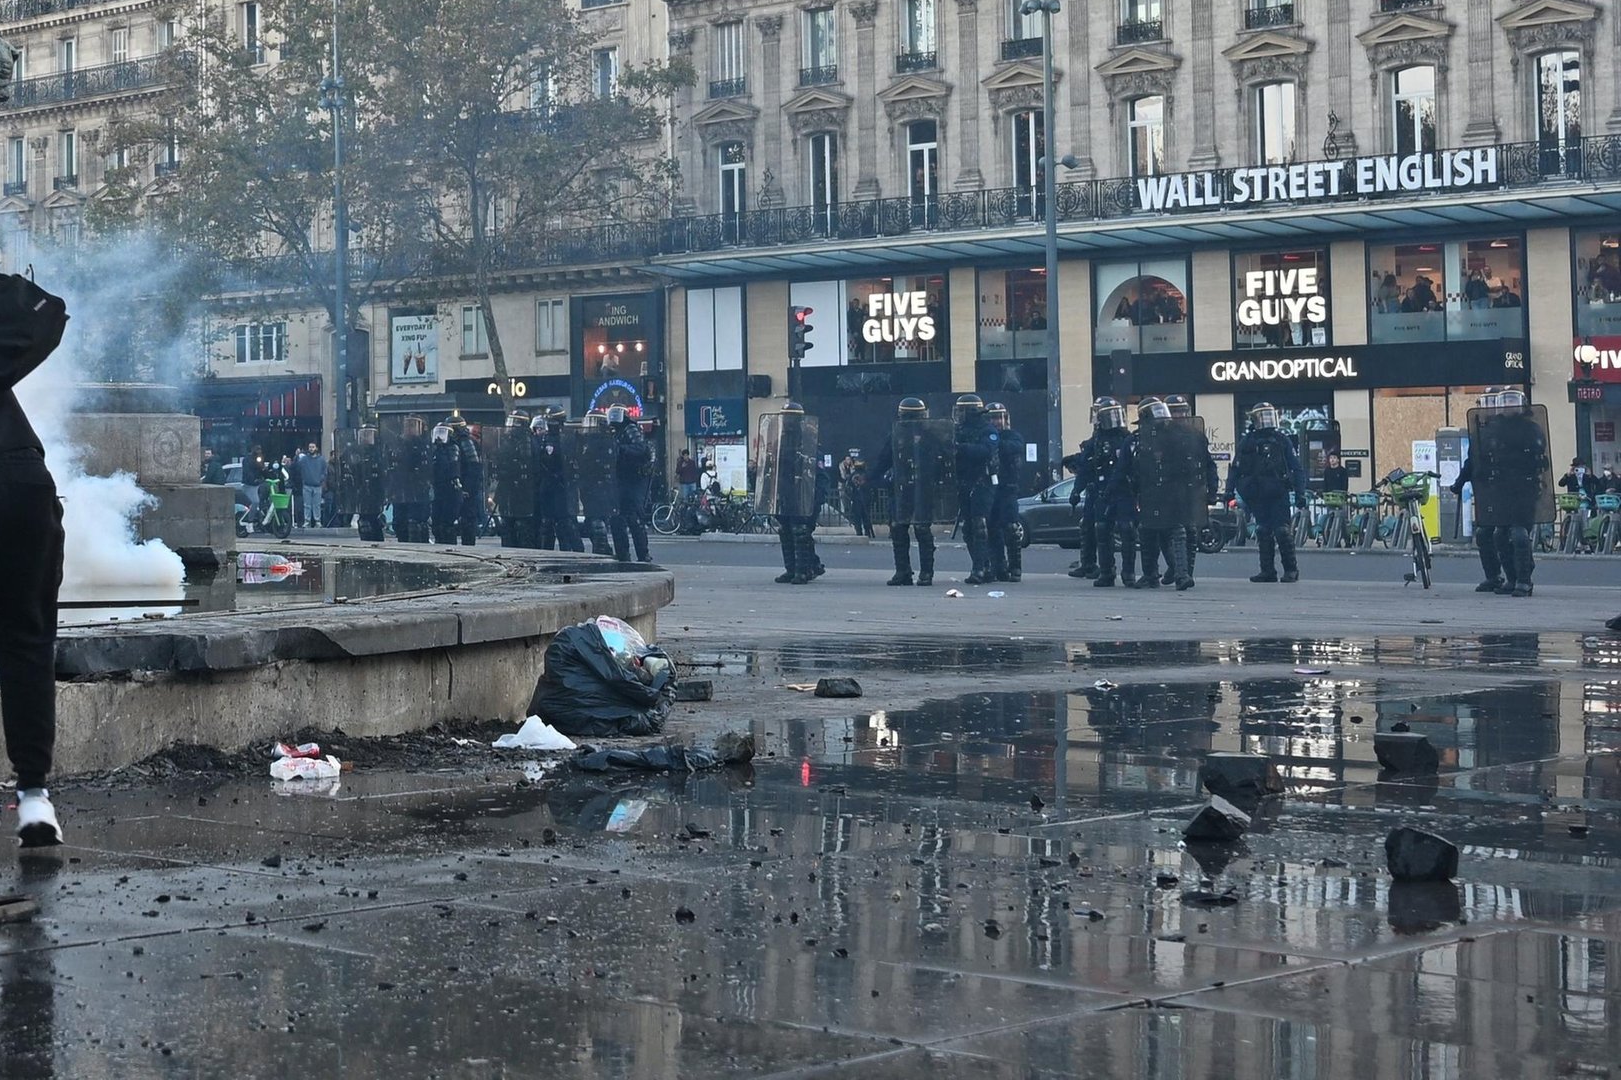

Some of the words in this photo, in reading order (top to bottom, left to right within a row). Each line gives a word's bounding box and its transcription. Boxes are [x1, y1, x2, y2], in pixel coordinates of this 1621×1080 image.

[1137, 174, 1220, 211] WALL
[1232, 160, 1345, 203] STREET
[1356, 148, 1497, 194] ENGLISH
[1245, 267, 1318, 295] FIVE
[868, 291, 928, 318] FIVE
[1237, 296, 1326, 327] GUYS
[396, 324, 426, 332] EVERYDAY
[862, 317, 936, 344] GUYS
[1210, 357, 1358, 381] GRANDOPTICAL
